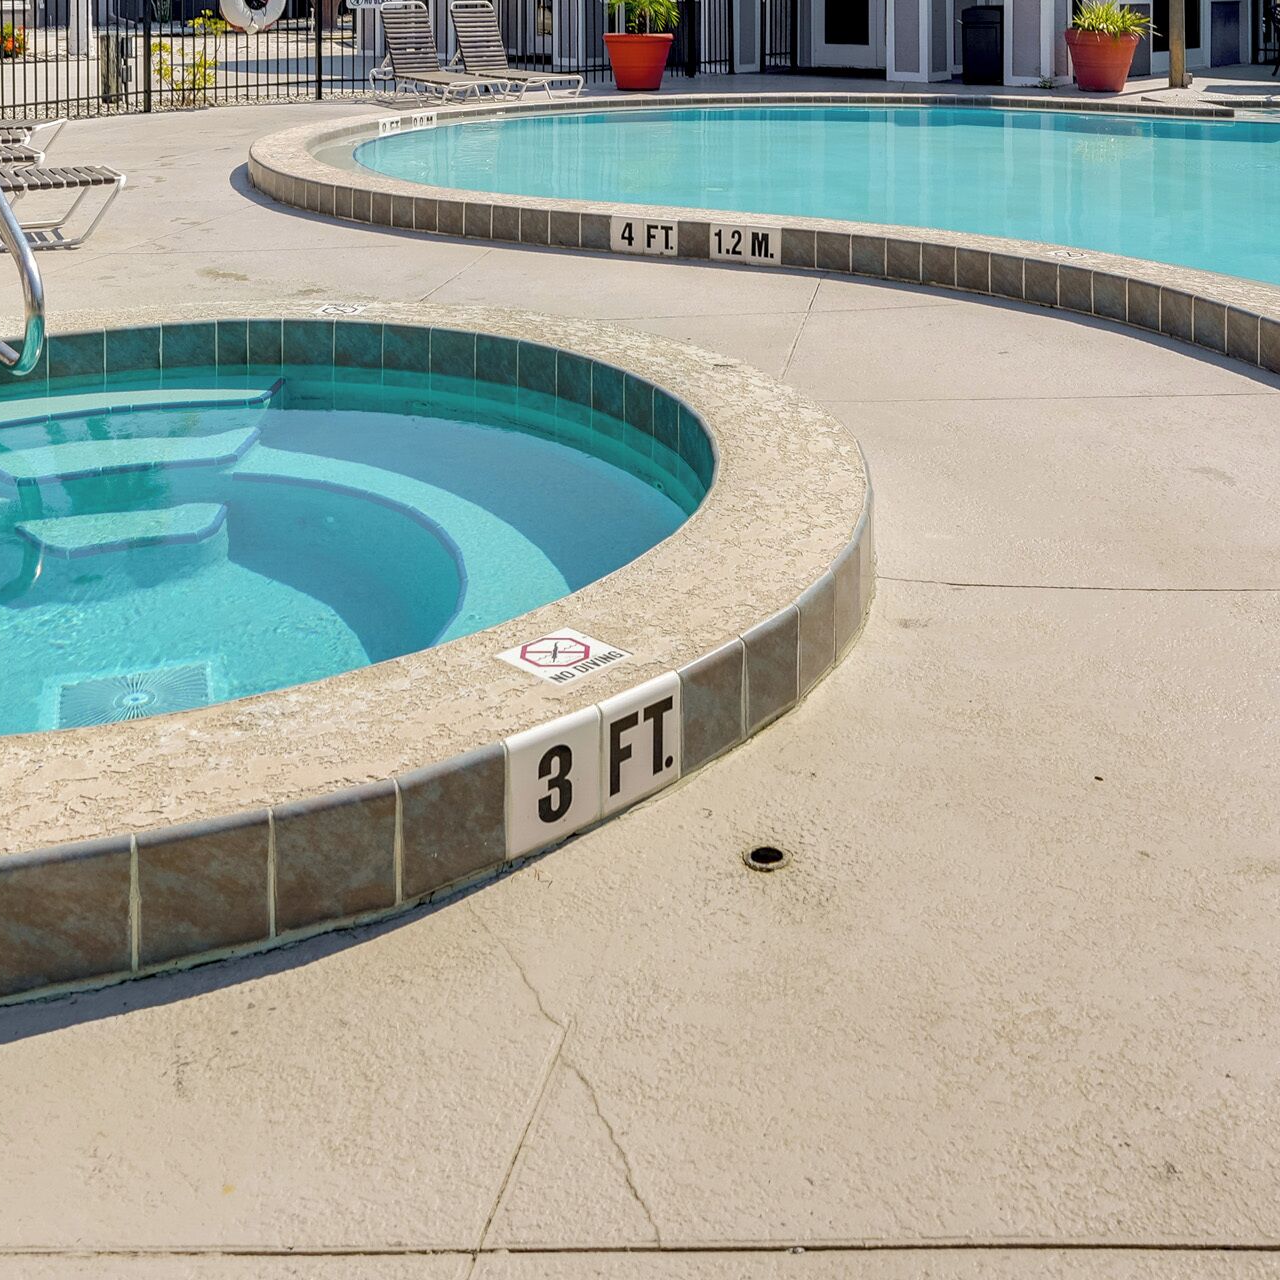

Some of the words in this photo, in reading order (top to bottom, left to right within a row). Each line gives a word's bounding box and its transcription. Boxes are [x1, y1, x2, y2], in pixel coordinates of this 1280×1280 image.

[621, 222, 634, 247] 4
[646, 224, 674, 251] FT.
[714, 228, 742, 256] 1.2
[751, 231, 774, 259] M.
[549, 670, 576, 684] NO
[572, 650, 624, 674] DIVING
[537, 743, 573, 824] 3
[609, 695, 674, 798] FT.
